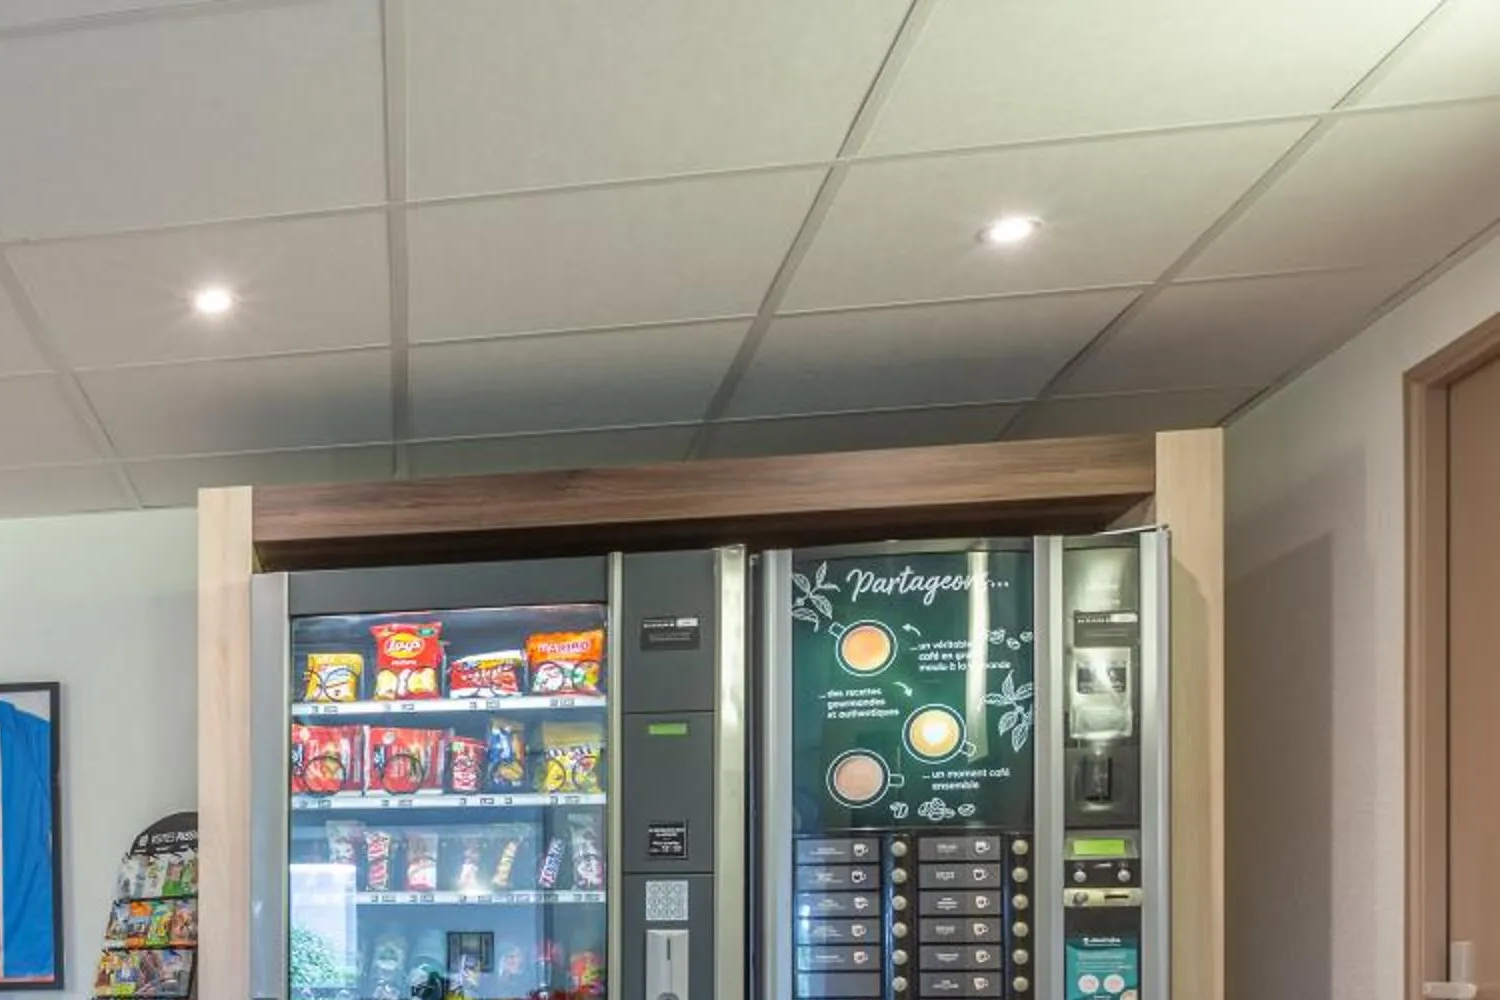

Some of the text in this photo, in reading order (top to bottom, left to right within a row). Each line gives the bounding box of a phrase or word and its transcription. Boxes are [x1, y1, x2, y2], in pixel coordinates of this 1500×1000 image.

[846, 565, 1009, 606] Partageon...
[988, 767, 1011, 777] café
[931, 780, 980, 790] ensemble
